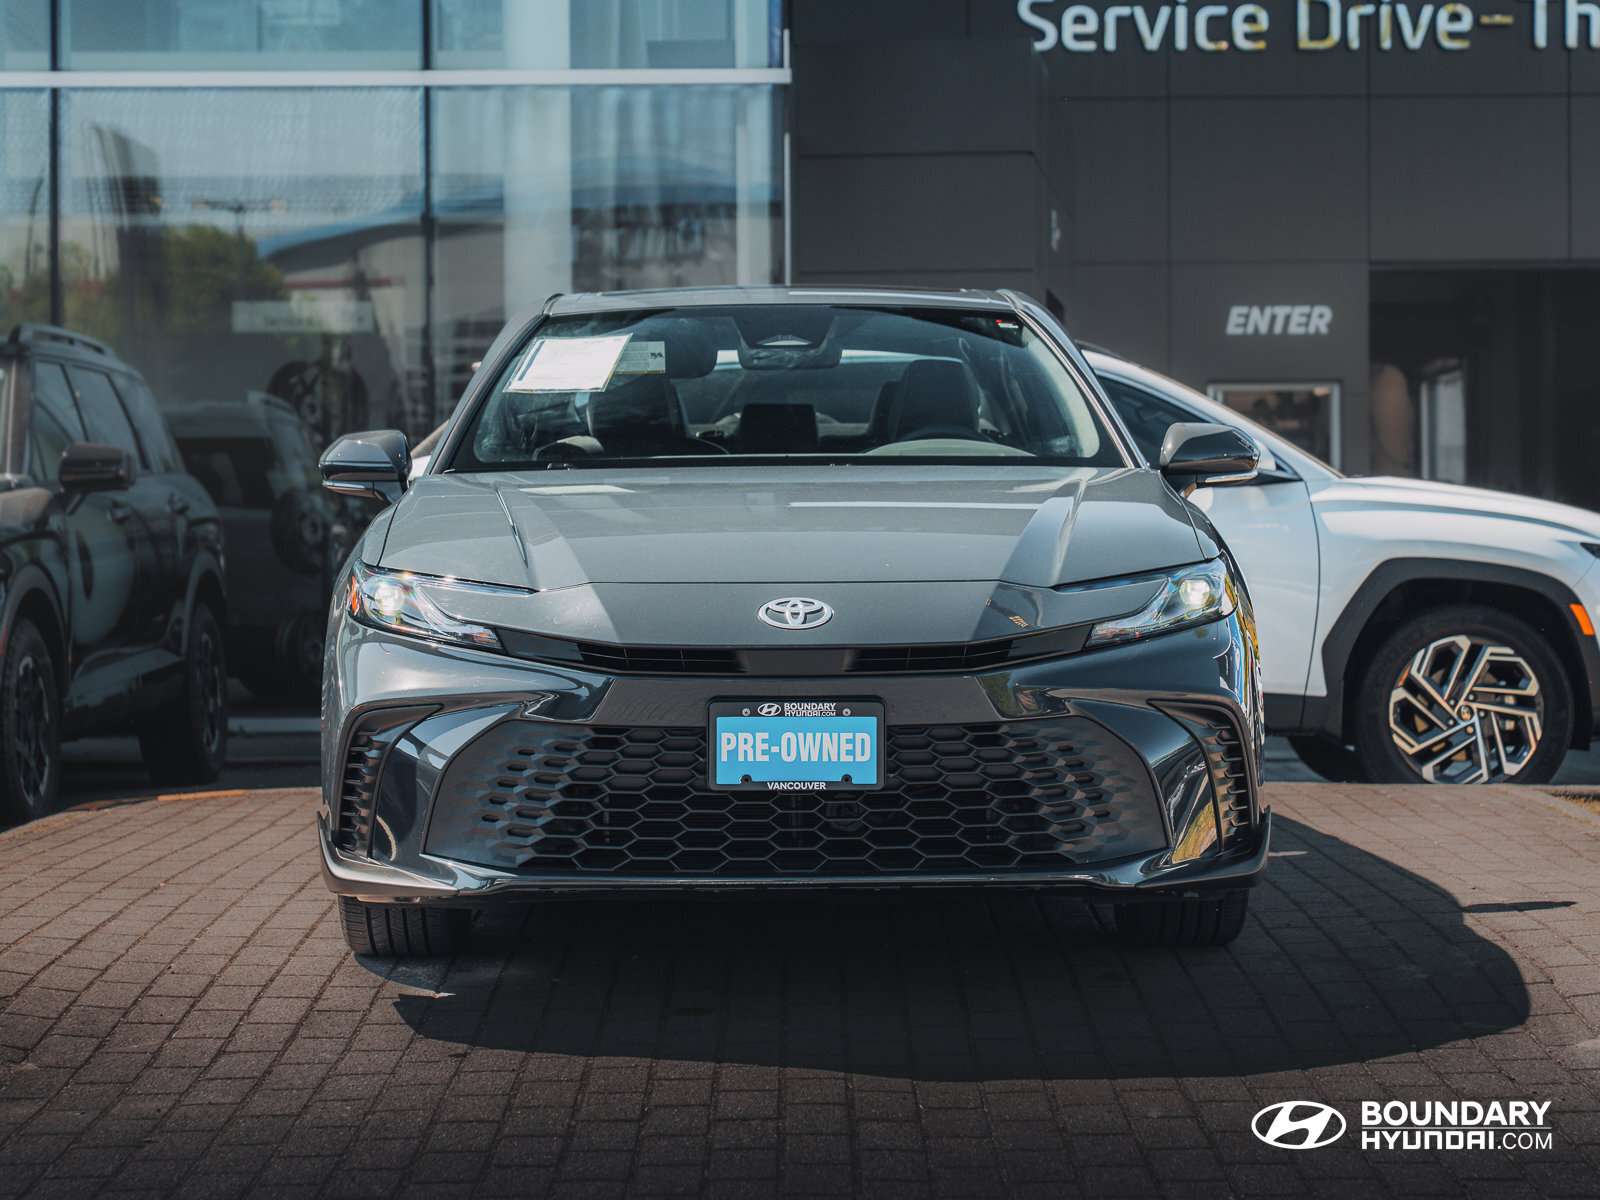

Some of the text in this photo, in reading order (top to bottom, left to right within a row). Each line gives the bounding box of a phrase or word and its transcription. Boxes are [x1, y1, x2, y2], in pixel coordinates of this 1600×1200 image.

[1017, 0, 1269, 51] Service
[1226, 304, 1333, 336] ENTER
[784, 702, 837, 711] BOUNDARY
[720, 731, 871, 763] PRE-OWNED
[767, 781, 827, 791] VANCOUVER
